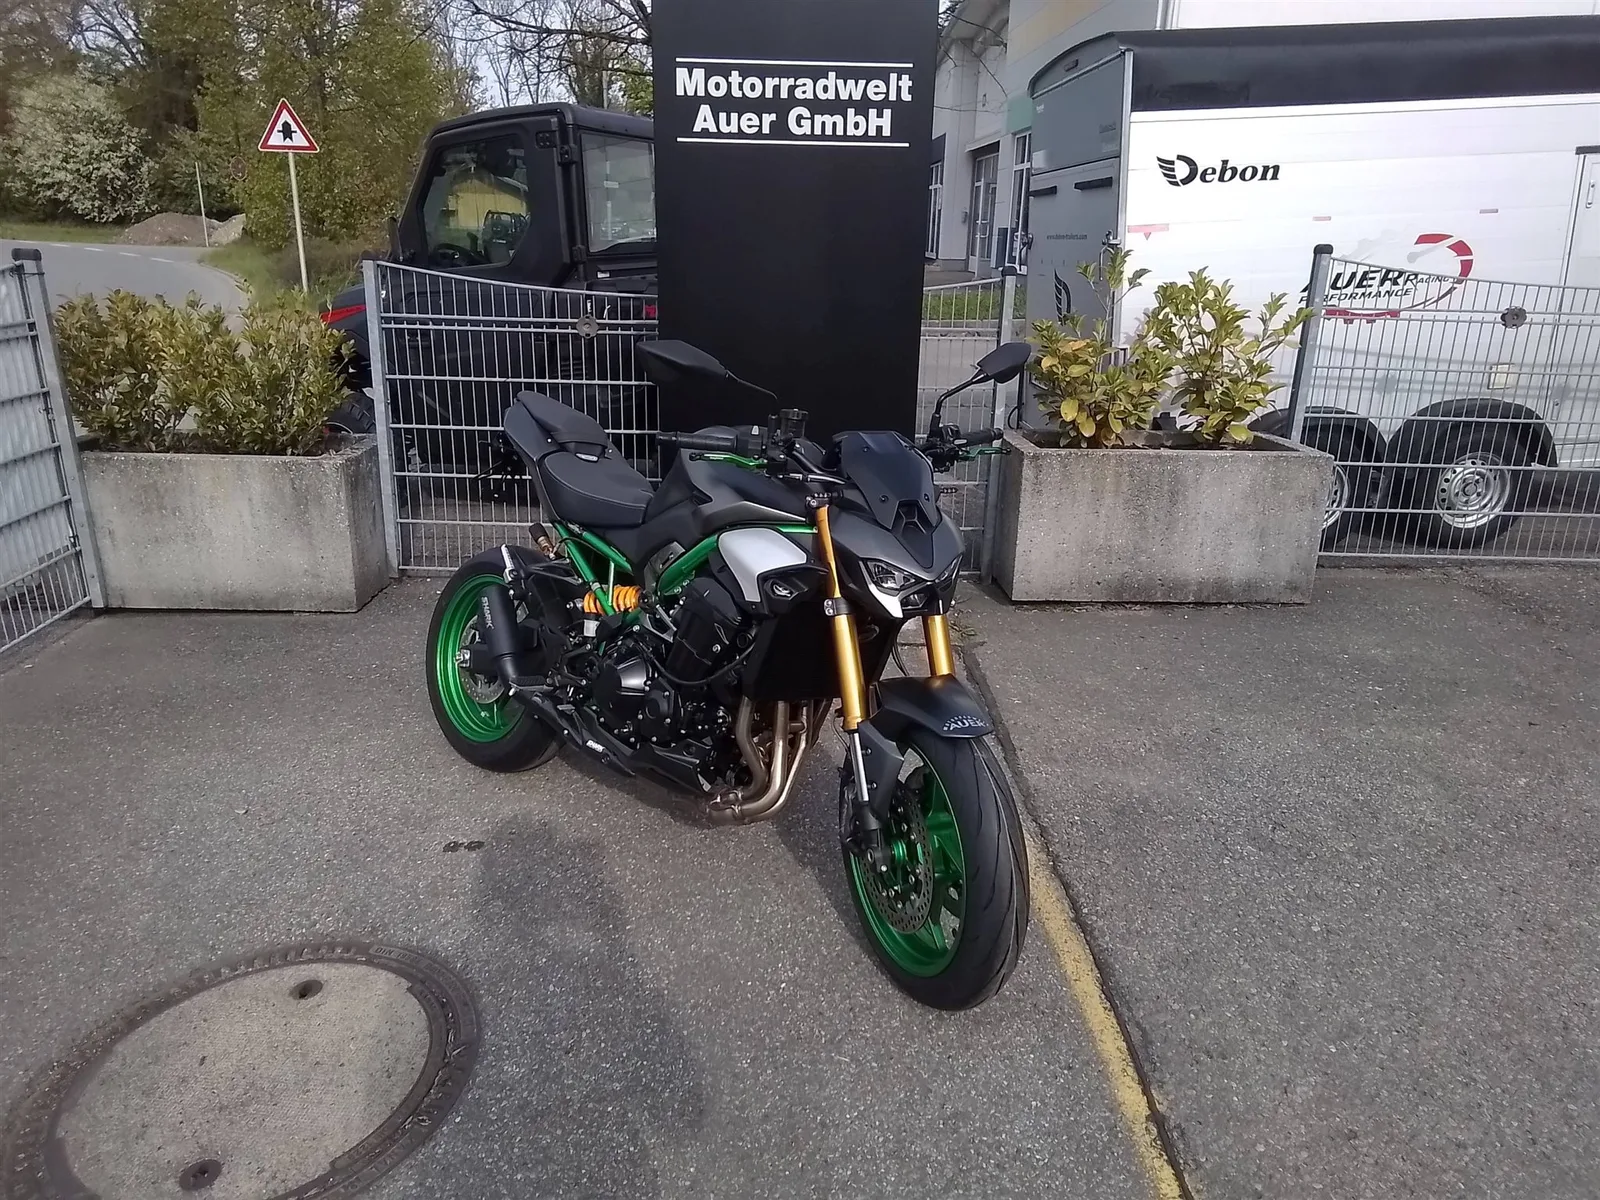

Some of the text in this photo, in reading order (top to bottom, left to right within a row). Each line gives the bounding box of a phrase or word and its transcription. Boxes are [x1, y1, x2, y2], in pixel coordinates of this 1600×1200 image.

[675, 67, 913, 102] Motorradwelt
[692, 104, 892, 137] Auer GmbH
[1156, 154, 1280, 187] Debon
[1299, 287, 1414, 304] PFORMANCE
[1300, 268, 1405, 293] UER
